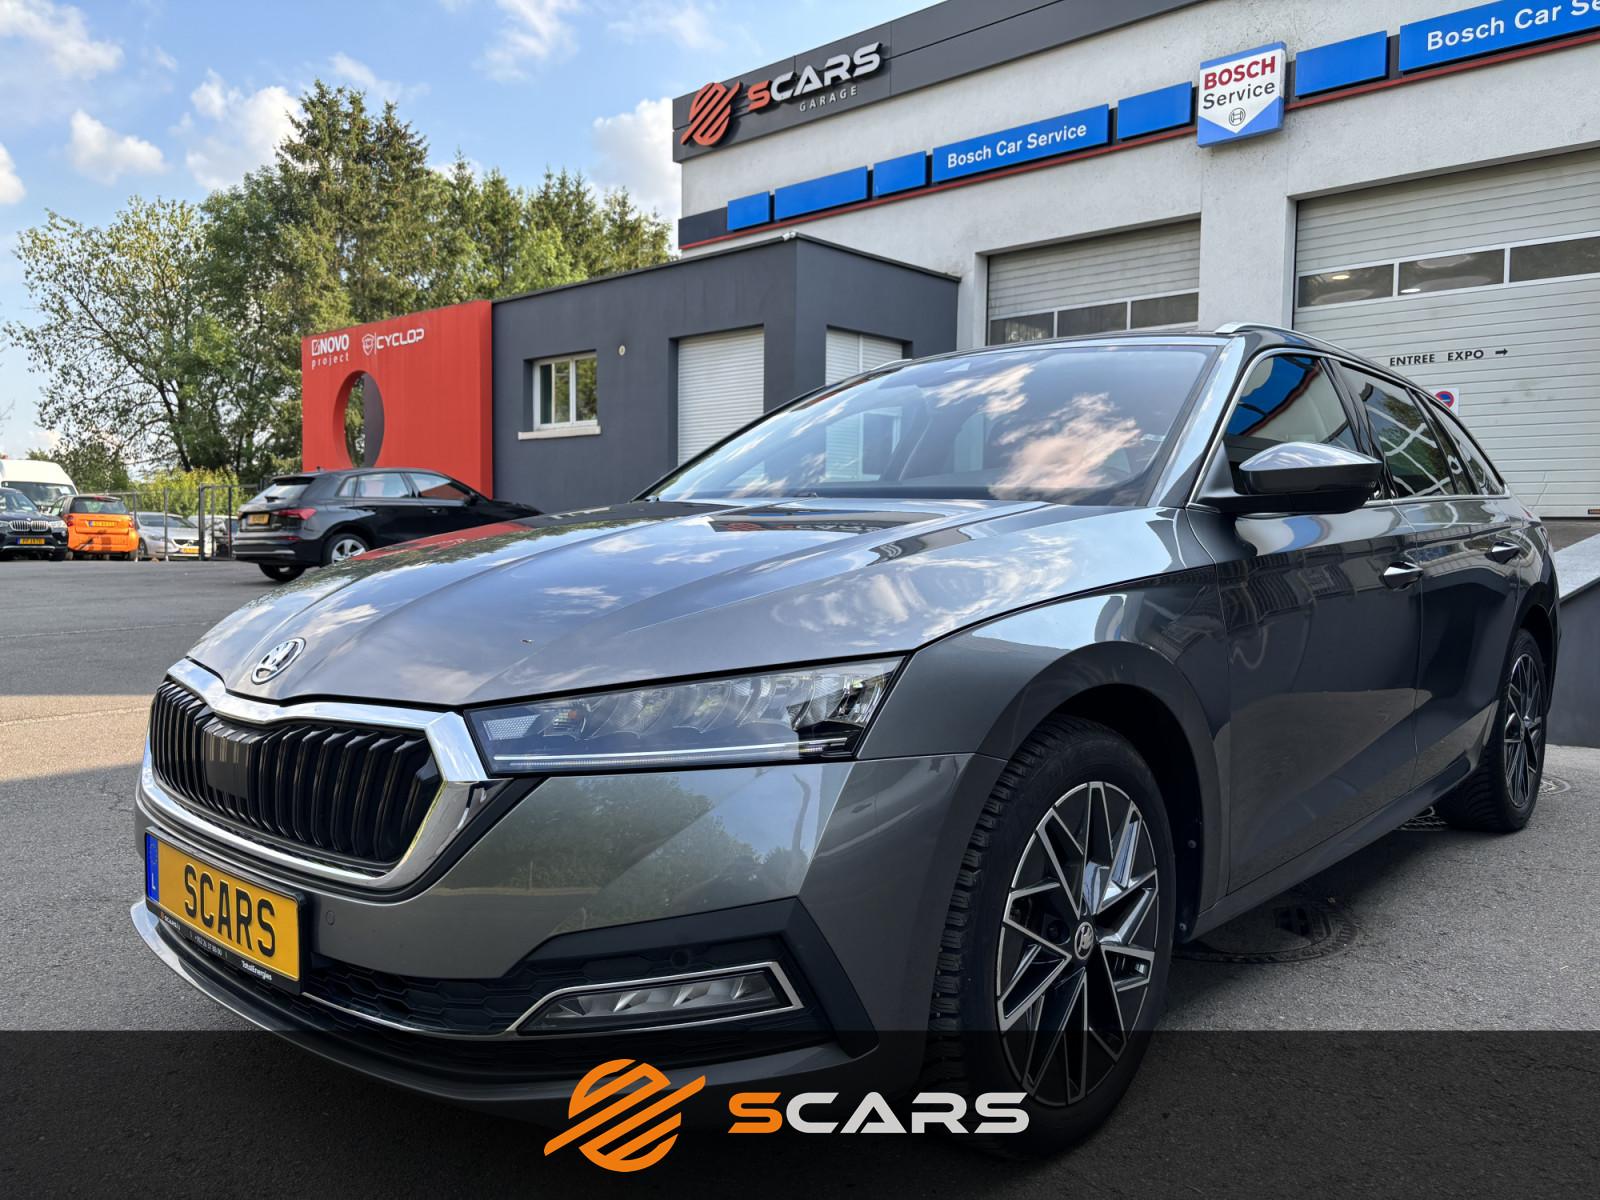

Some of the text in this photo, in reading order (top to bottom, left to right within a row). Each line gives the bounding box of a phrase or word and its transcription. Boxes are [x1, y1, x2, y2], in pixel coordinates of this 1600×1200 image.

[1427, 17, 1504, 51] Bosch
[1515, 5, 1562, 30] Car
[748, 41, 882, 112] SCARS
[1203, 56, 1276, 91] BOSCH
[799, 86, 858, 112] GARAGE
[1203, 82, 1276, 110] Service
[947, 124, 1088, 169] Bosch Car Service
[376, 328, 425, 350] CYCLOP
[311, 351, 349, 370] project
[1389, 349, 1485, 367] ENTREE EXPO
[151, 872, 157, 891] L
[184, 863, 276, 958] SCARS
